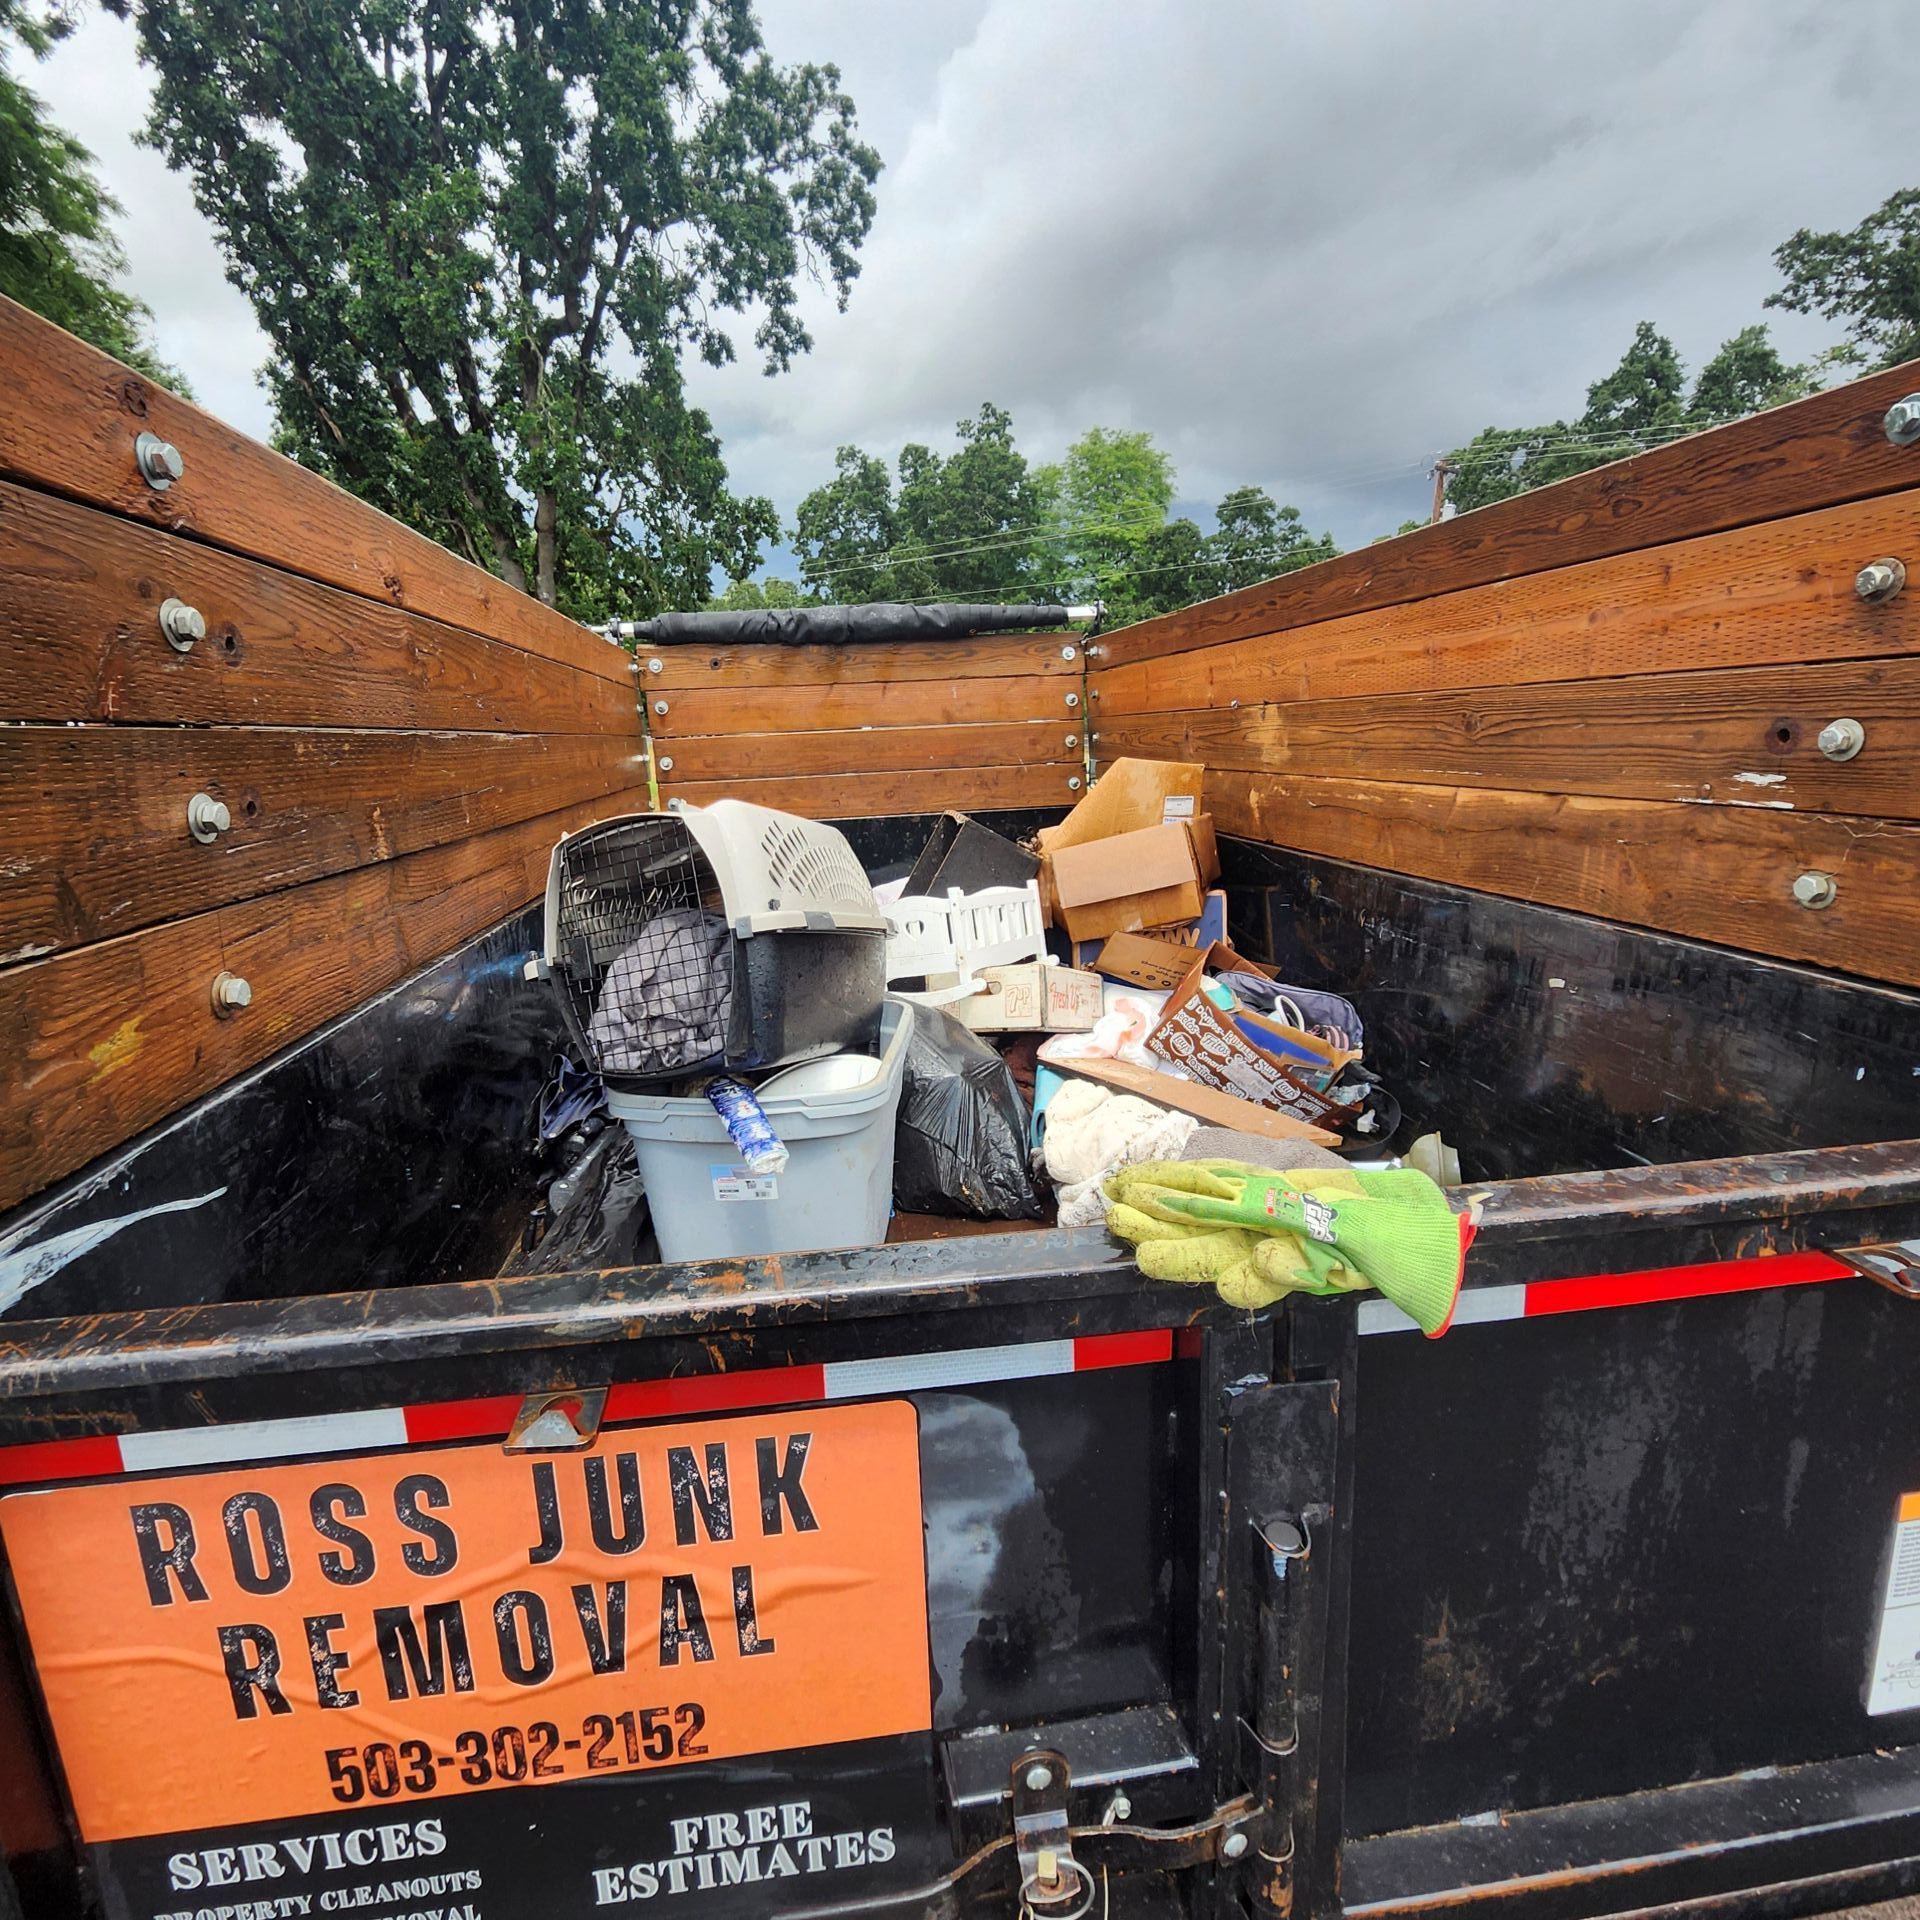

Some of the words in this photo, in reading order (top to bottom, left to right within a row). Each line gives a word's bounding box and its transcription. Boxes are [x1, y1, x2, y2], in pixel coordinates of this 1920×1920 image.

[129, 1473, 458, 1607] ROSS
[528, 1432, 820, 1565] JUNK
[217, 1564, 776, 1720] REMOVAL
[324, 1702, 710, 1804] 503-302-2152
[168, 1818, 448, 1891] SERVICES
[591, 1827, 896, 1905] ESTIMATES
[670, 1801, 813, 1855] FREE
[320, 1869, 482, 1911] CLEANOUTS
